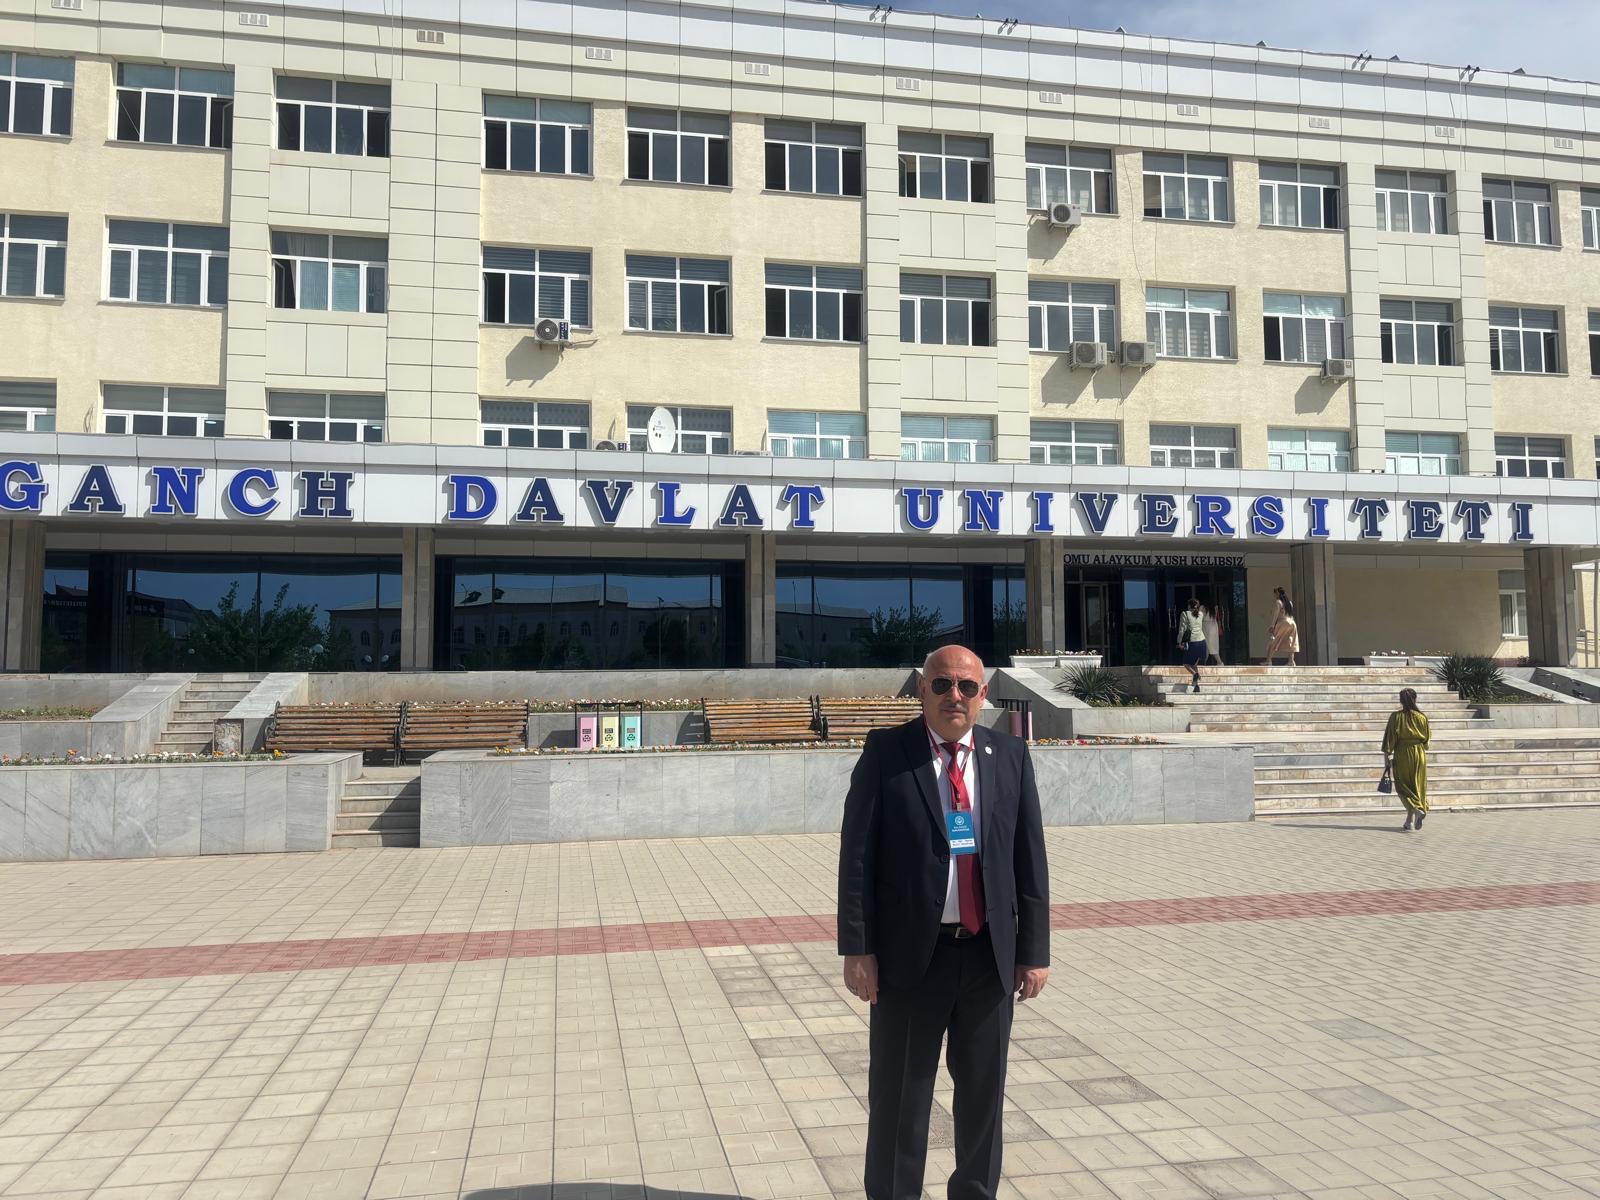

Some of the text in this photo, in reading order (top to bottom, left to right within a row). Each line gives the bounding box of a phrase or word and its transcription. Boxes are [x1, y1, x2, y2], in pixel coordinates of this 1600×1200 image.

[0, 459, 1534, 541] GANCH DAVLAT UNIVERSITETI
[1093, 554, 1151, 565] ALAYKUM
[1154, 555, 1187, 566] XUSH
[1191, 556, 1244, 567] KELIBSIZ
